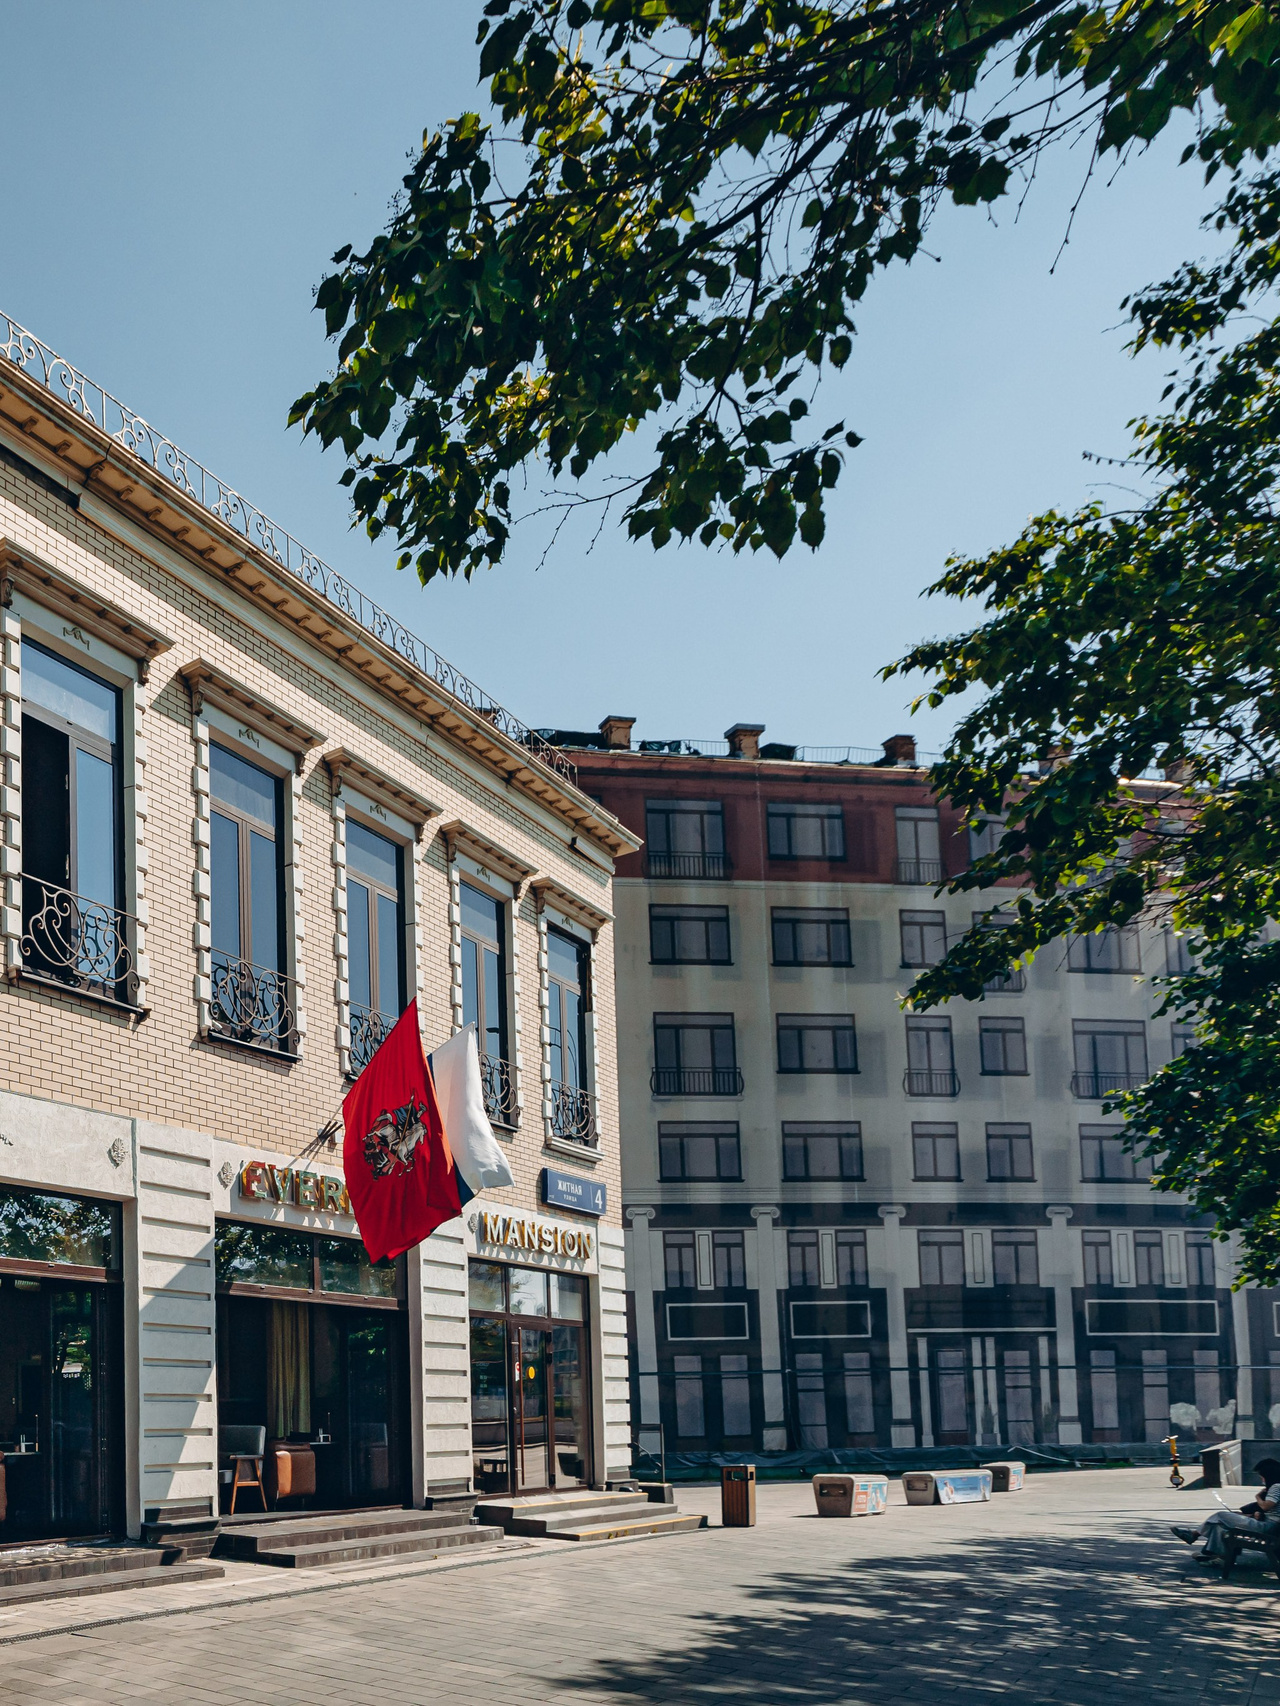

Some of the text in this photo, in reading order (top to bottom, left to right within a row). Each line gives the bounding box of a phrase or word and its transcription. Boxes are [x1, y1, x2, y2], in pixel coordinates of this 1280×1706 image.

[241, 1160, 355, 1215] EVER
[557, 1180, 583, 1196] ЖИТНАЯ
[594, 1189, 603, 1209] 4
[483, 1211, 593, 1259] MANSION
